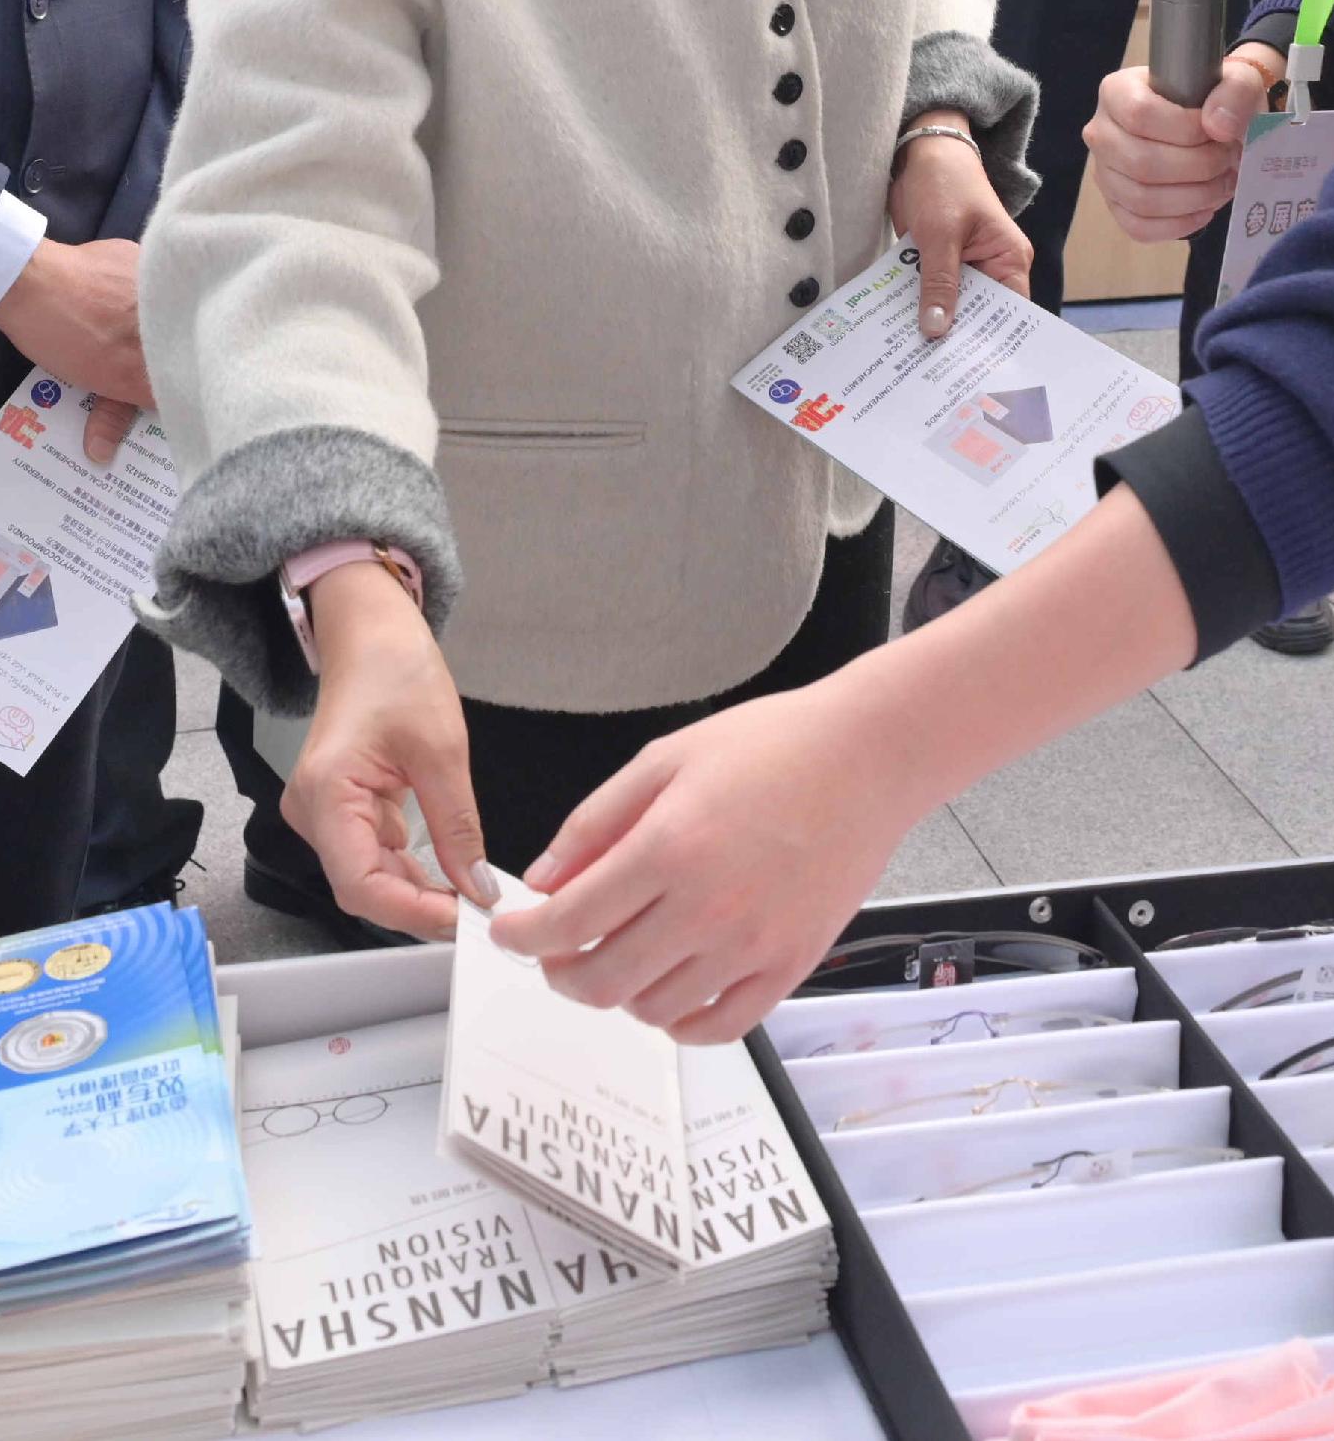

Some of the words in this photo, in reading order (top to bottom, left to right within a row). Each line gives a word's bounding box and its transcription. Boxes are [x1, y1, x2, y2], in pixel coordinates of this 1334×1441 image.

[11, 456, 56, 490] UNIVERSITY
[39, 440, 90, 478] BIOCHEMIST
[86, 472, 113, 493] LOCAL
[54, 485, 99, 518] RENOWNED
[6, 522, 80, 574] PHYTOCOMPOUNDS
[78, 570, 113, 596] NATURAL
[507, 1093, 678, 1203] TRANQUIL
[561, 1099, 674, 1182] VISION
[461, 1094, 681, 1248] NANSHA
[378, 1214, 513, 1264] VISION
[321, 1241, 522, 1304] TRANQUIL
[273, 1269, 537, 1359] NANSHA
